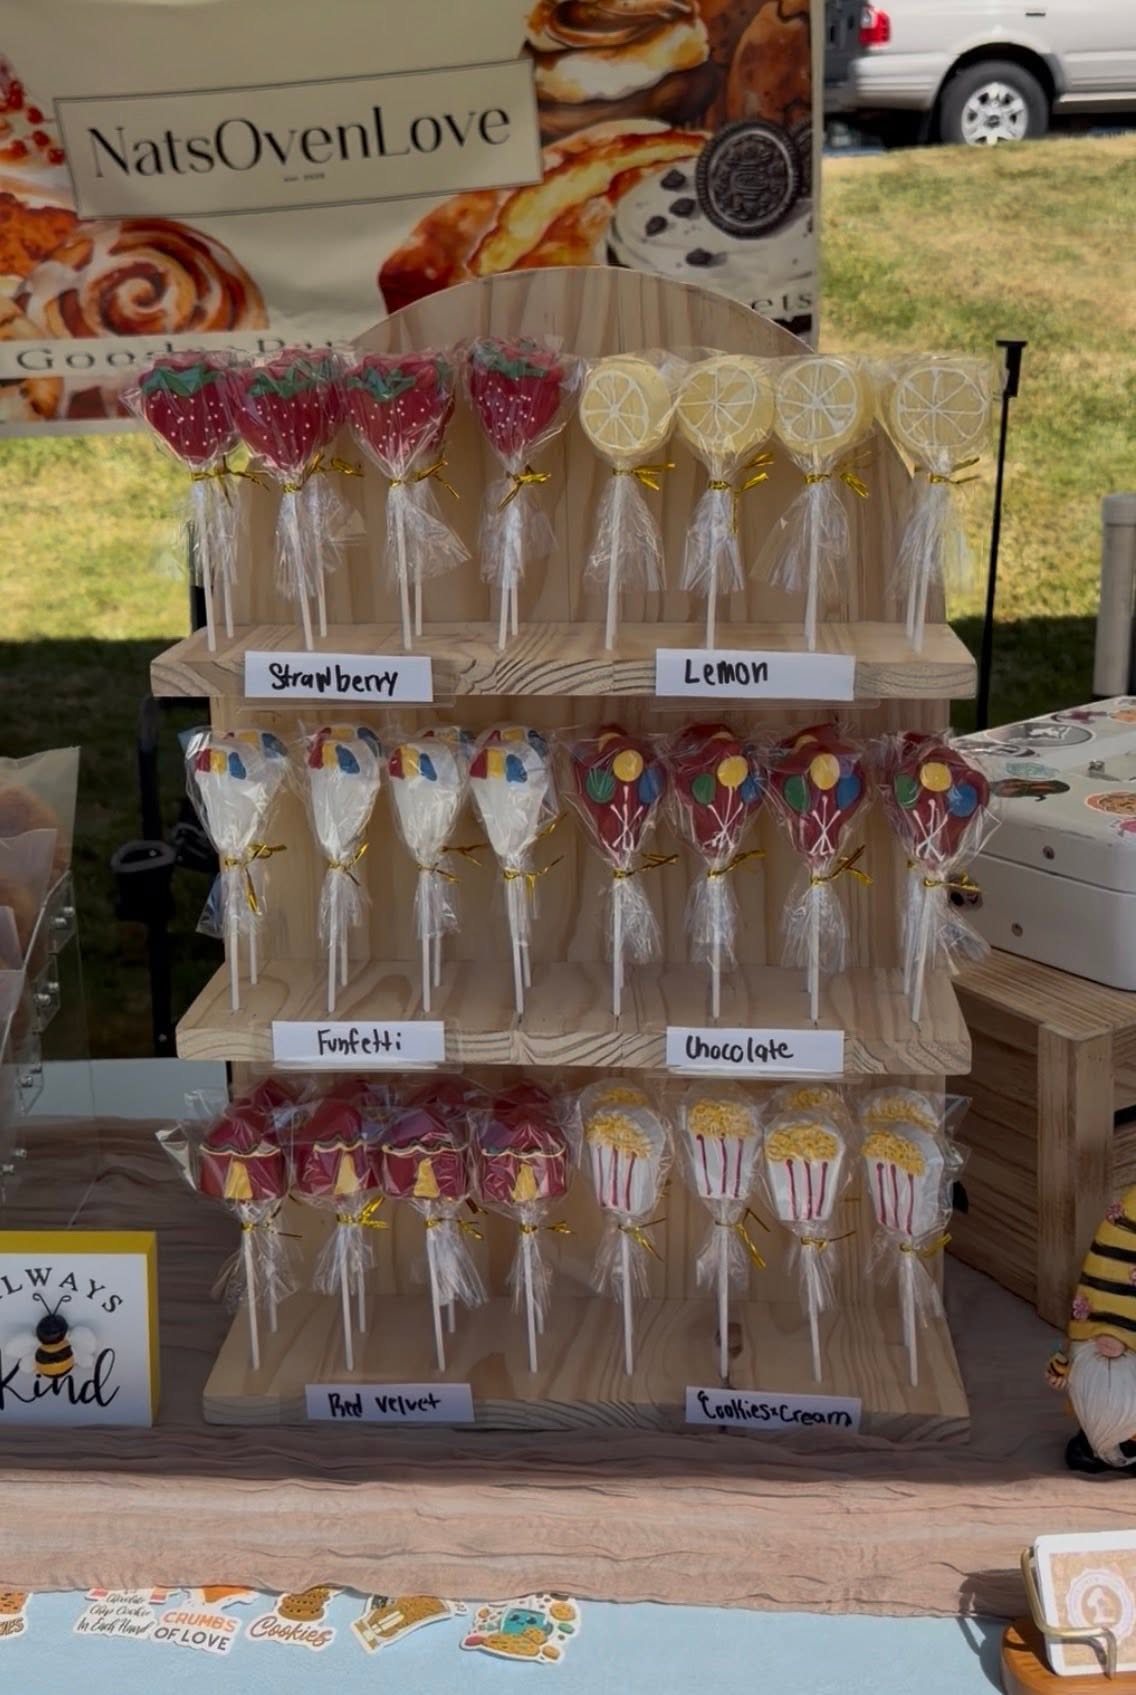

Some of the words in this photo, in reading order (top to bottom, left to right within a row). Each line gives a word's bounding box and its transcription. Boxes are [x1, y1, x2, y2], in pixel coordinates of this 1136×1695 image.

[87, 105, 511, 178] NatsOvenLove
[269, 662, 399, 697] Strawberry
[684, 658, 769, 686] Lemon
[317, 1027, 402, 1056] Funfetti
[0, 1267, 123, 1313] LWAYS
[327, 1392, 363, 1418] Red
[163, 1611, 237, 1633] CRUMBS
[250, 1615, 333, 1647] Cookies
[154, 1626, 180, 1641] OF
[181, 1629, 231, 1651] LOVE
